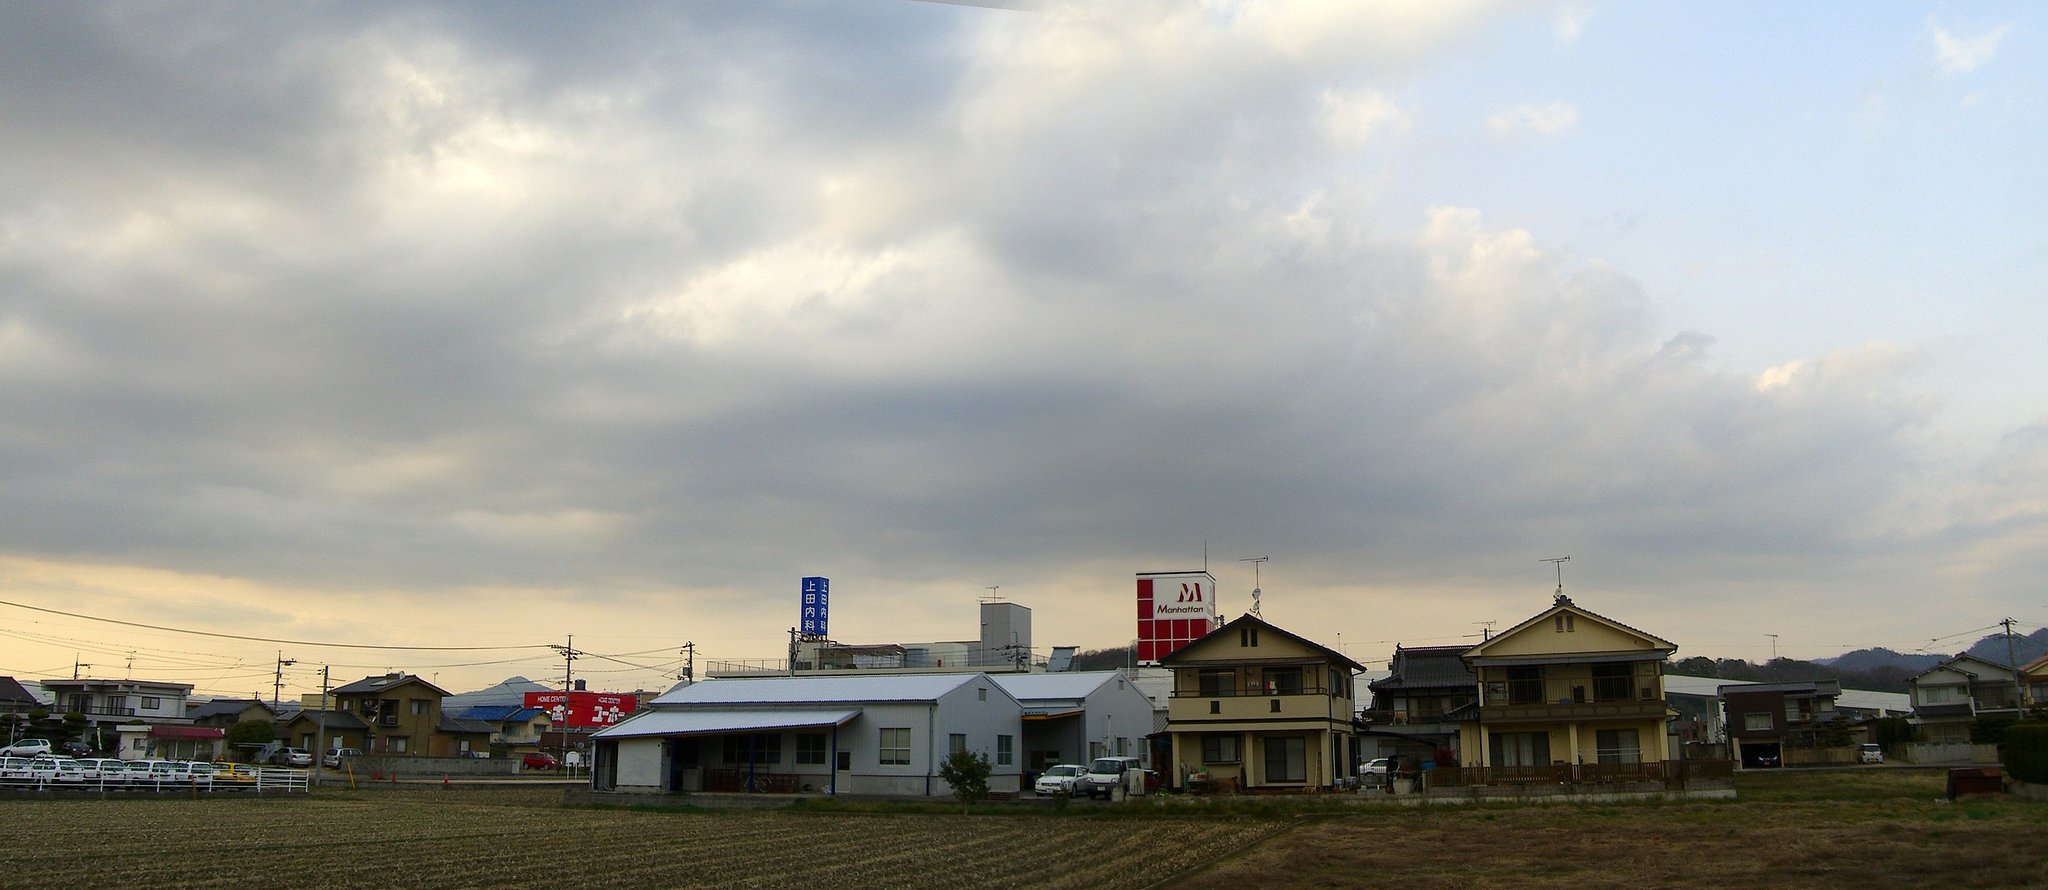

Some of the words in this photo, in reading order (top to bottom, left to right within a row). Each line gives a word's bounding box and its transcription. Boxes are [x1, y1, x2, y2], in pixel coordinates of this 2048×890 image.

[805, 580, 816, 630] 上田内科
[1157, 604, 1204, 614] Manhattan
[538, 695, 550, 703] HOME
[551, 695, 566, 703] CENTE
